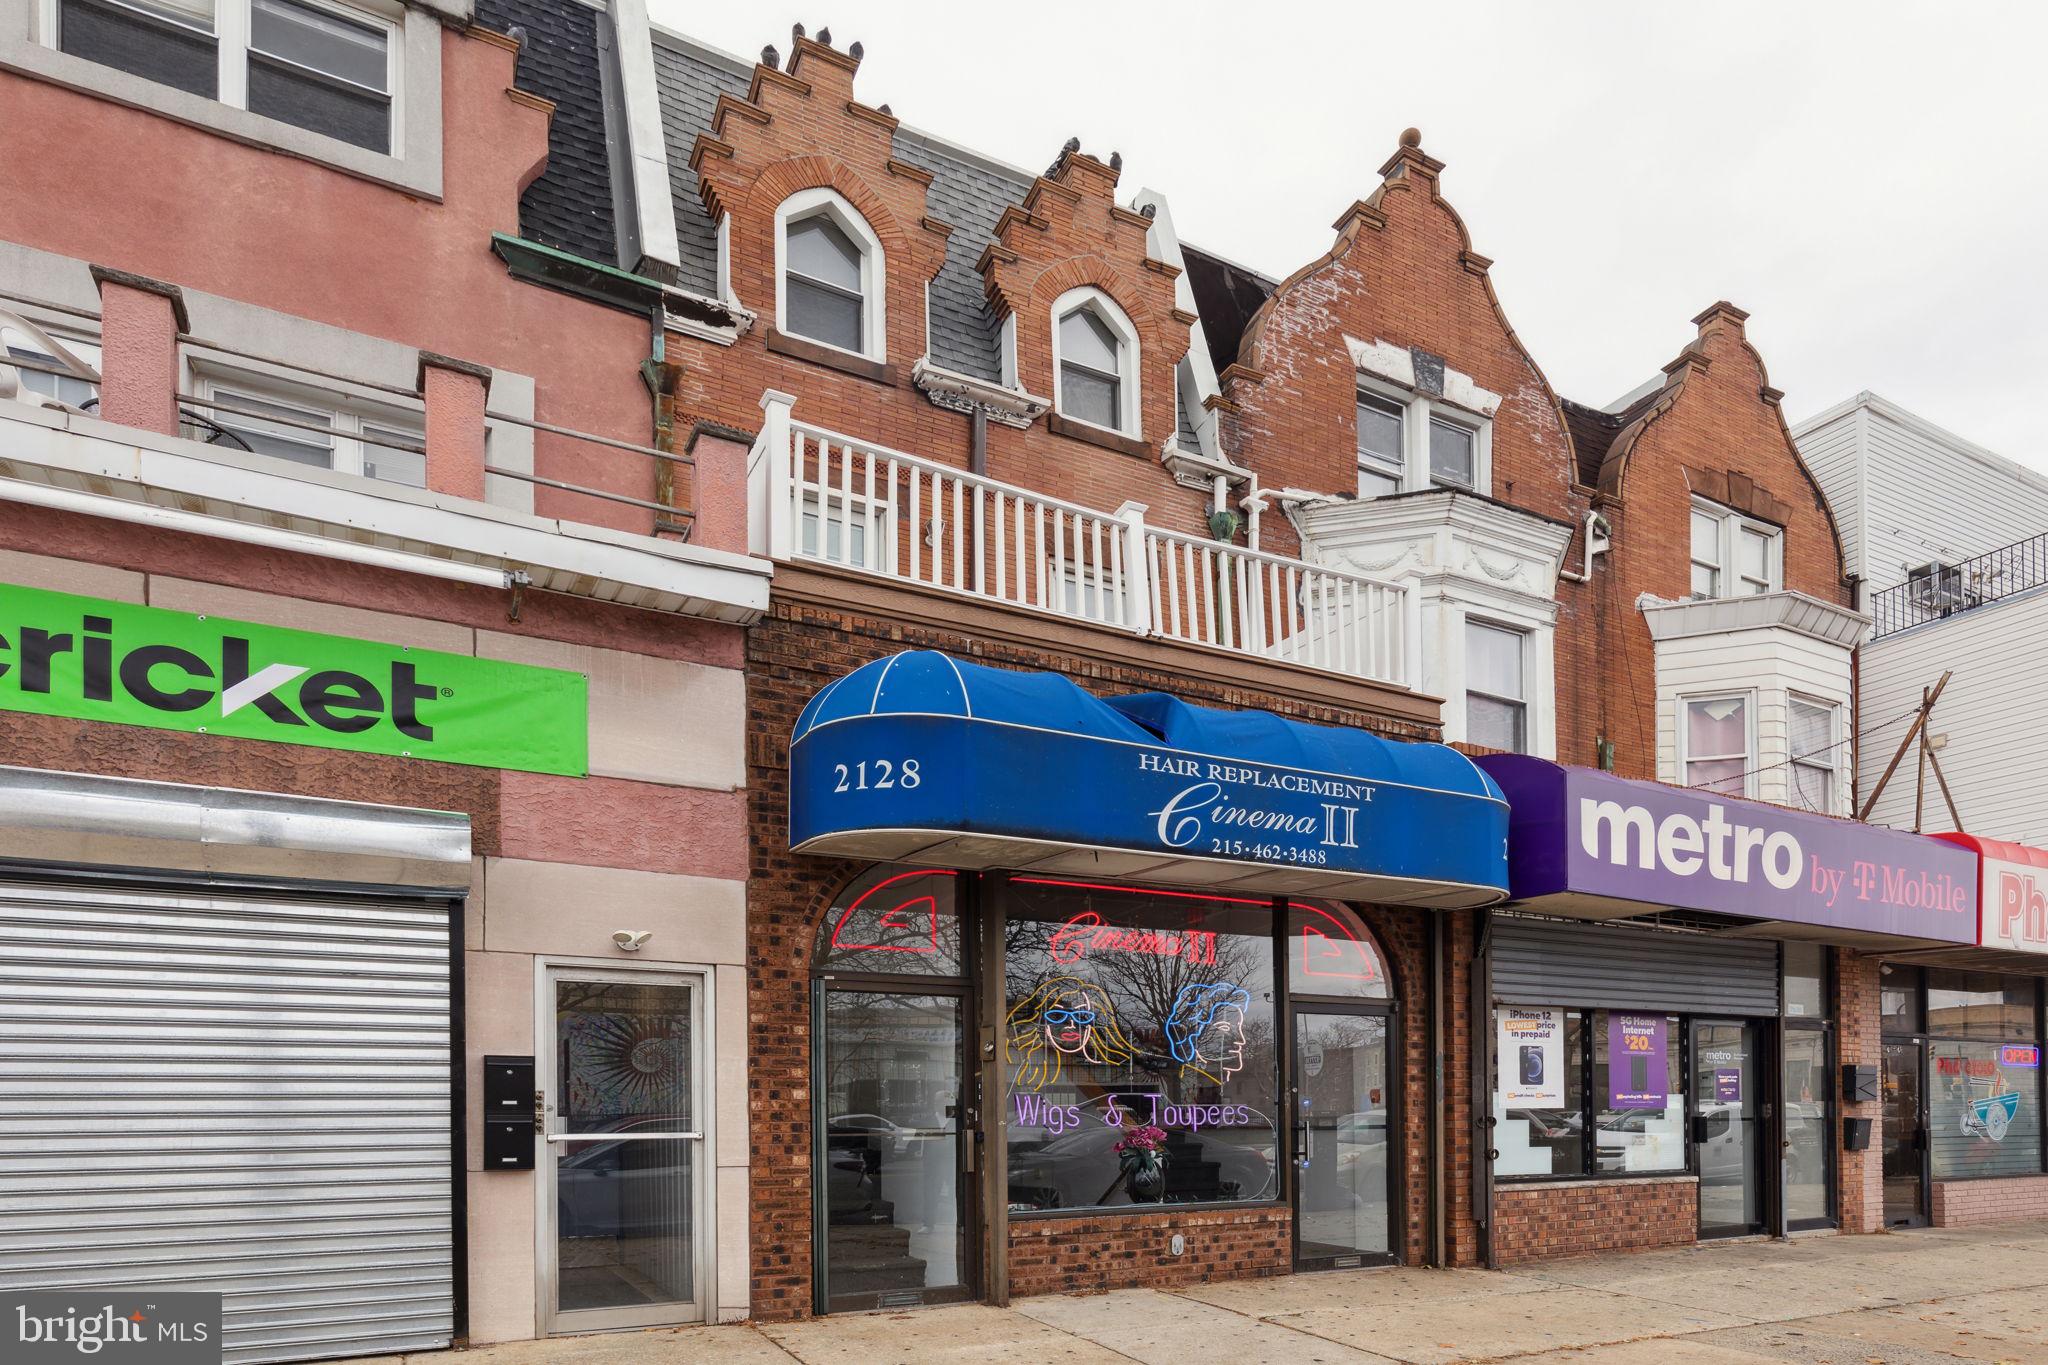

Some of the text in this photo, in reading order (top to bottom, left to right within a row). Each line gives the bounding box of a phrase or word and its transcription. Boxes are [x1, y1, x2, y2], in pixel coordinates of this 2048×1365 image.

[834, 759, 920, 792] 2128
[1139, 754, 1376, 801] HAIR REPLACEMENT
[1148, 782, 1359, 848] Cinema II
[1581, 797, 1803, 890] metro
[1810, 855, 1846, 907] by
[1048, 911, 1217, 964] Cinema II
[1509, 1010, 1552, 1020] iPhone 12
[1620, 1016, 1657, 1026] 5G Home
[1507, 1021, 1556, 1030] LOWEST price
[1622, 1026, 1655, 1035] Internet
[1511, 1029, 1551, 1040] in prepaid
[1624, 1034, 1649, 1051] $20
[1706, 1050, 1731, 1061] metro
[2004, 1049, 2037, 1063] OPEN
[1015, 1094, 1249, 1135] Wigs & Toupees
